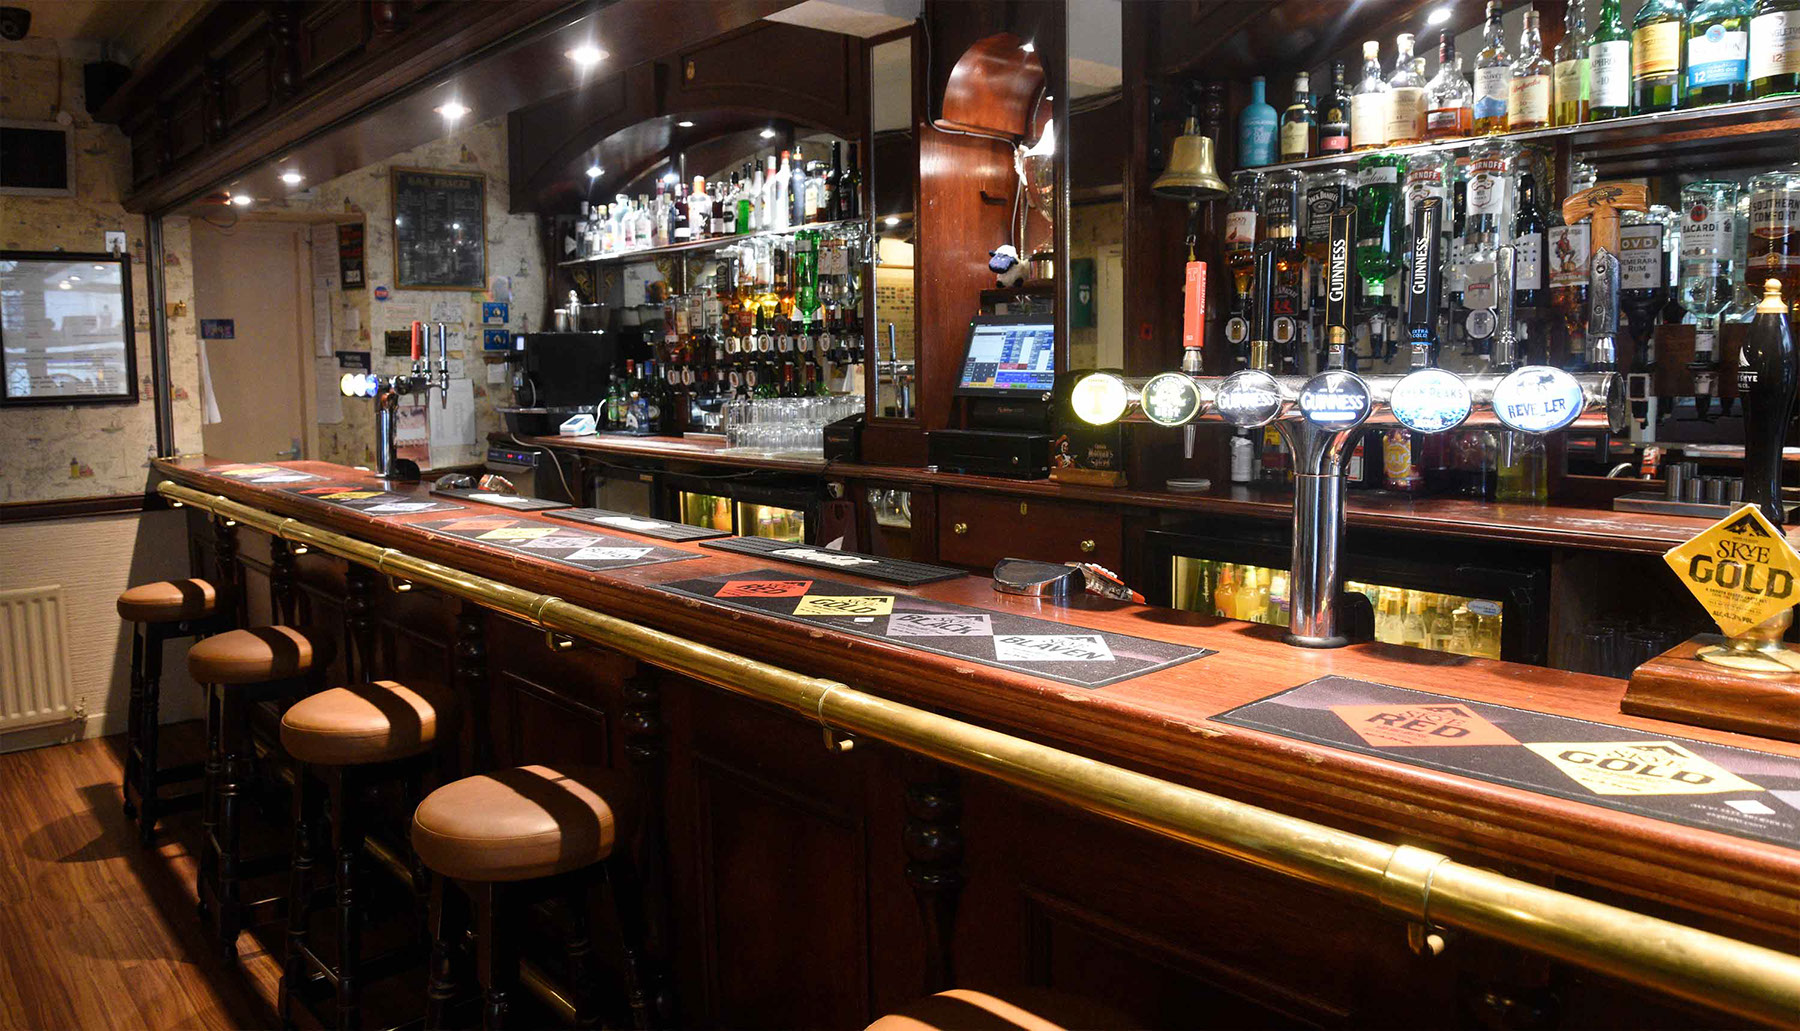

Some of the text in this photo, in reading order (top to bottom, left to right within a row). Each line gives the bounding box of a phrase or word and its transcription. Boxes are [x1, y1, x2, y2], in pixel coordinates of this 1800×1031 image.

[1694, 70, 1706, 82] 12
[1329, 238, 1346, 302] GUINNESS
[1412, 237, 1429, 295] GUINNESS
[1628, 265, 1647, 273] RUM
[1217, 391, 1277, 410] GUINNESS
[1300, 393, 1366, 411] GUINNESS
[1508, 398, 1566, 419] REVELER
[1717, 539, 1770, 564] SKYE
[1689, 554, 1794, 600] GOLD
[808, 598, 876, 614] GOLD
[896, 614, 977, 634] BLACK
[999, 636, 1106, 660] BLAVEN
[1365, 712, 1471, 738] RED
[1557, 750, 1716, 785] GOLD
